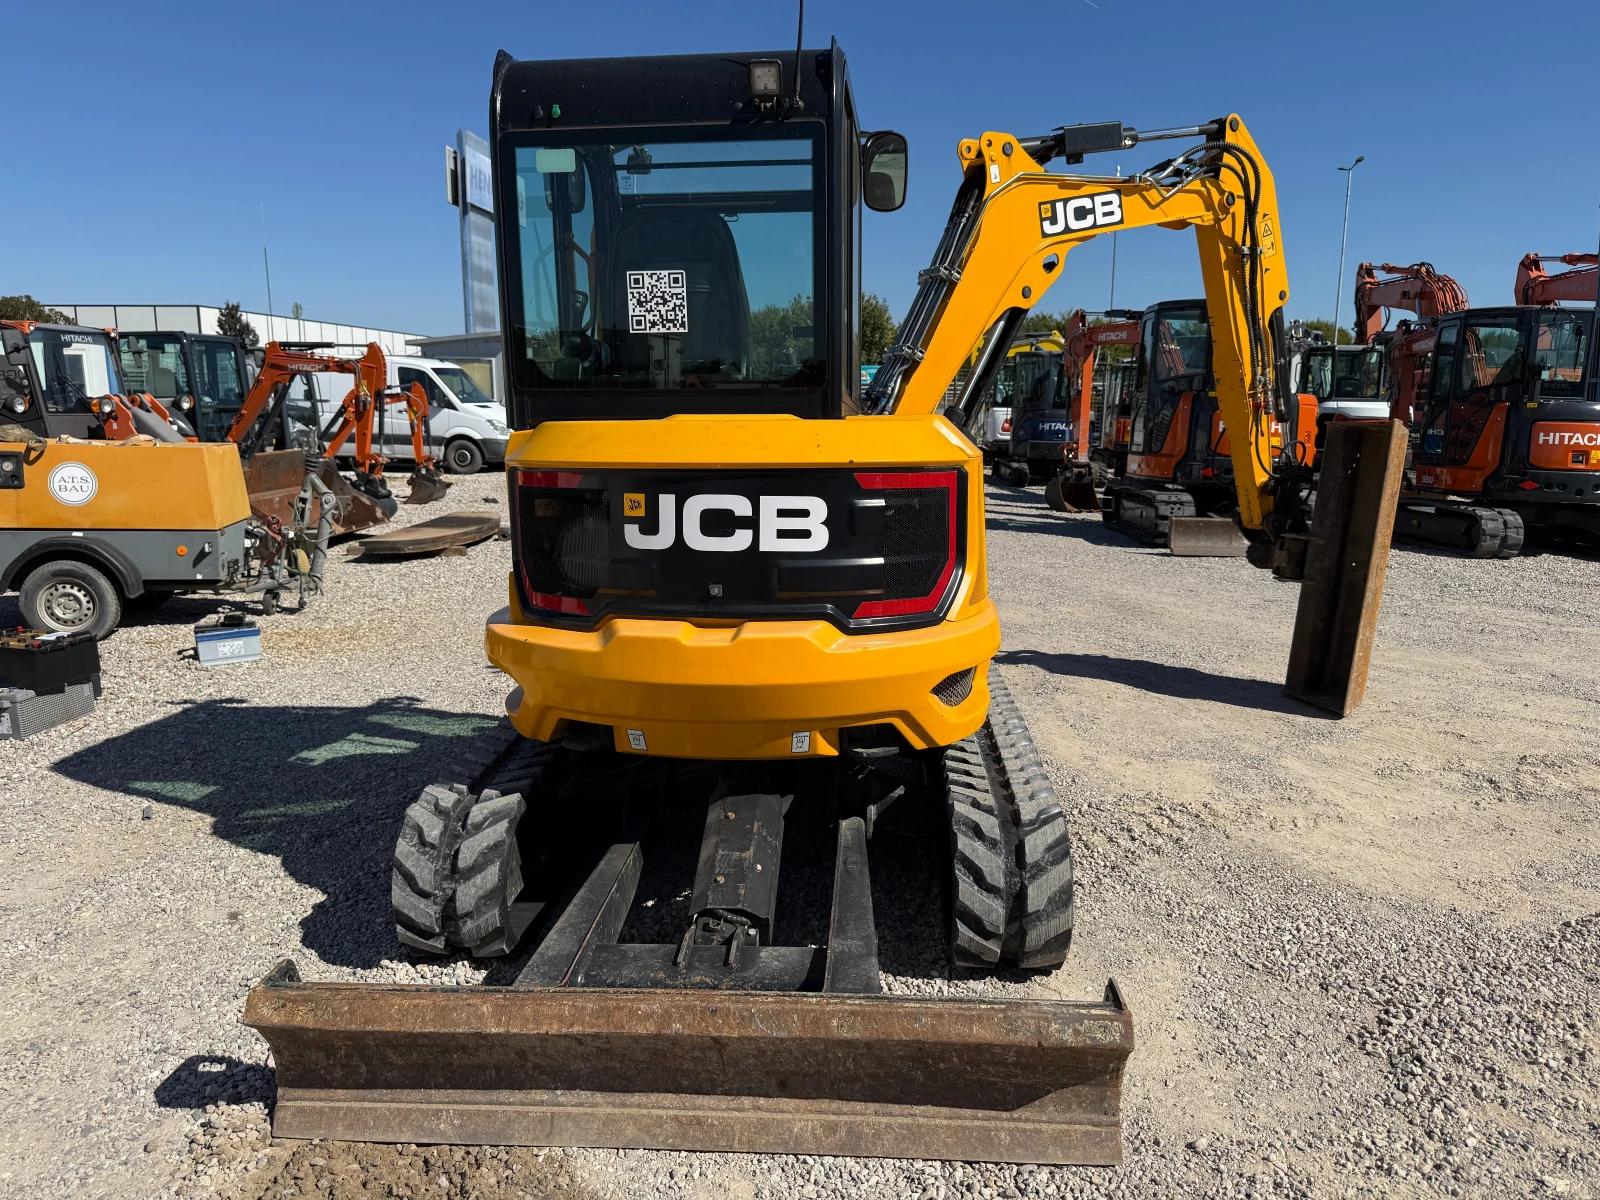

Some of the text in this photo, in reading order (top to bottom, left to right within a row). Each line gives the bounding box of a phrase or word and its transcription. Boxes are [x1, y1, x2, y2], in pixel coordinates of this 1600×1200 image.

[470, 164, 492, 196] HEN
[1042, 193, 1122, 234] JCB
[60, 334, 93, 343] HITACHI
[1098, 331, 1127, 341] HITACHI
[288, 363, 326, 372] HITACHI
[1538, 432, 1600, 446] HITAC
[57, 476, 91, 484] A.T.S.
[58, 485, 90, 493] BAU
[623, 493, 830, 552] JCB
